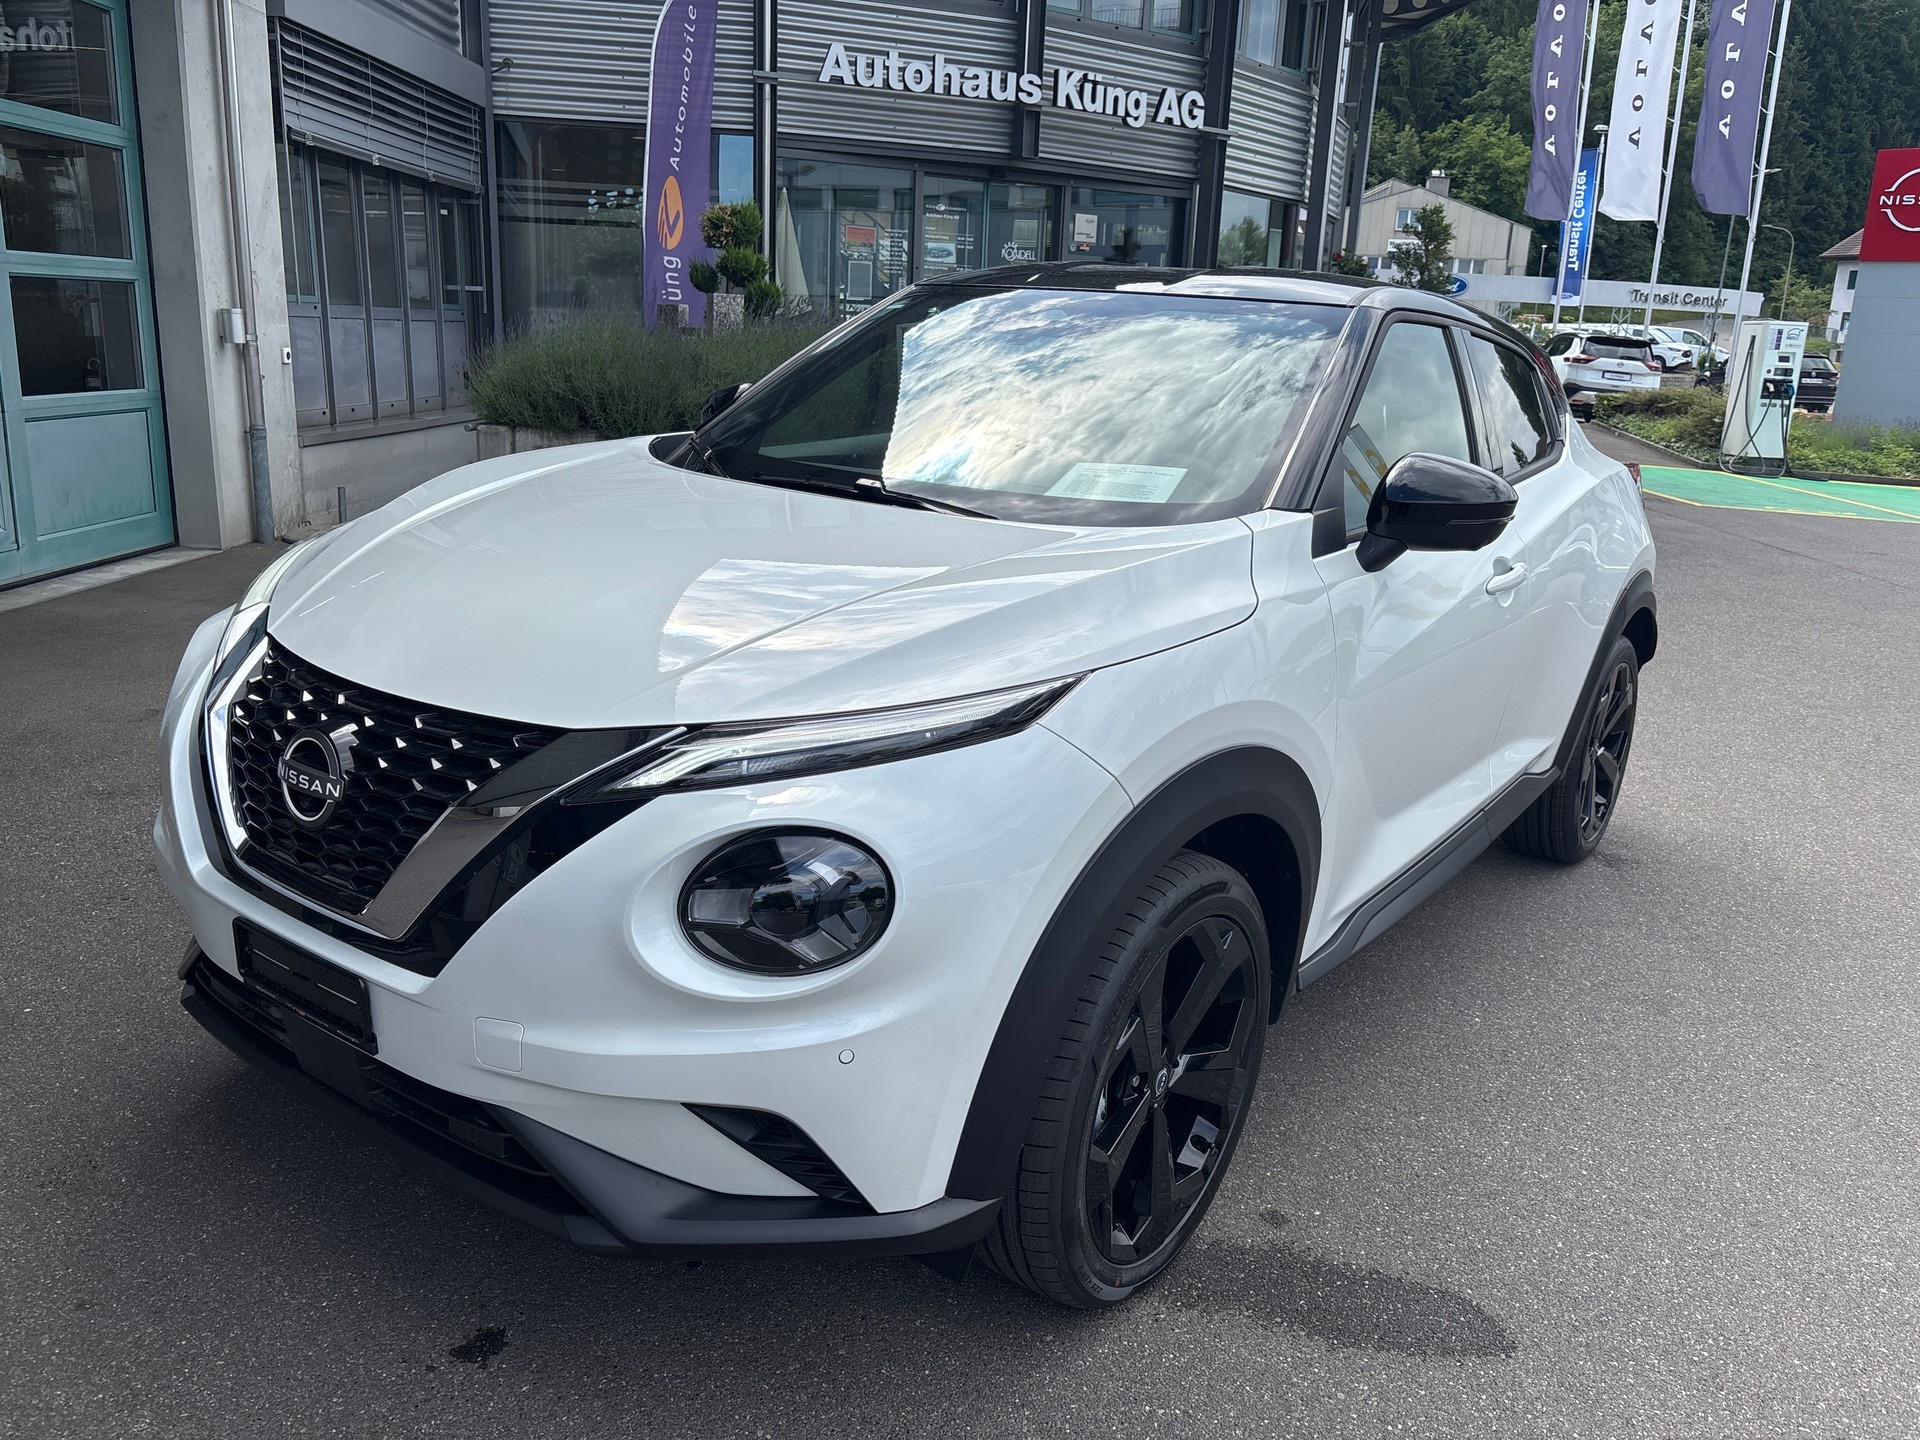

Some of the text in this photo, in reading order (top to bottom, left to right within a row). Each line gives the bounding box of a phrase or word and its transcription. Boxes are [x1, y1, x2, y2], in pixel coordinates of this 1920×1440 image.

[818, 41, 1205, 129] Autohaus Küng AG
[662, 5, 697, 301] üng Automobile
[1879, 195, 1920, 206] NIS
[1683, 292, 1729, 307] Center
[278, 763, 341, 798] NISSAN
